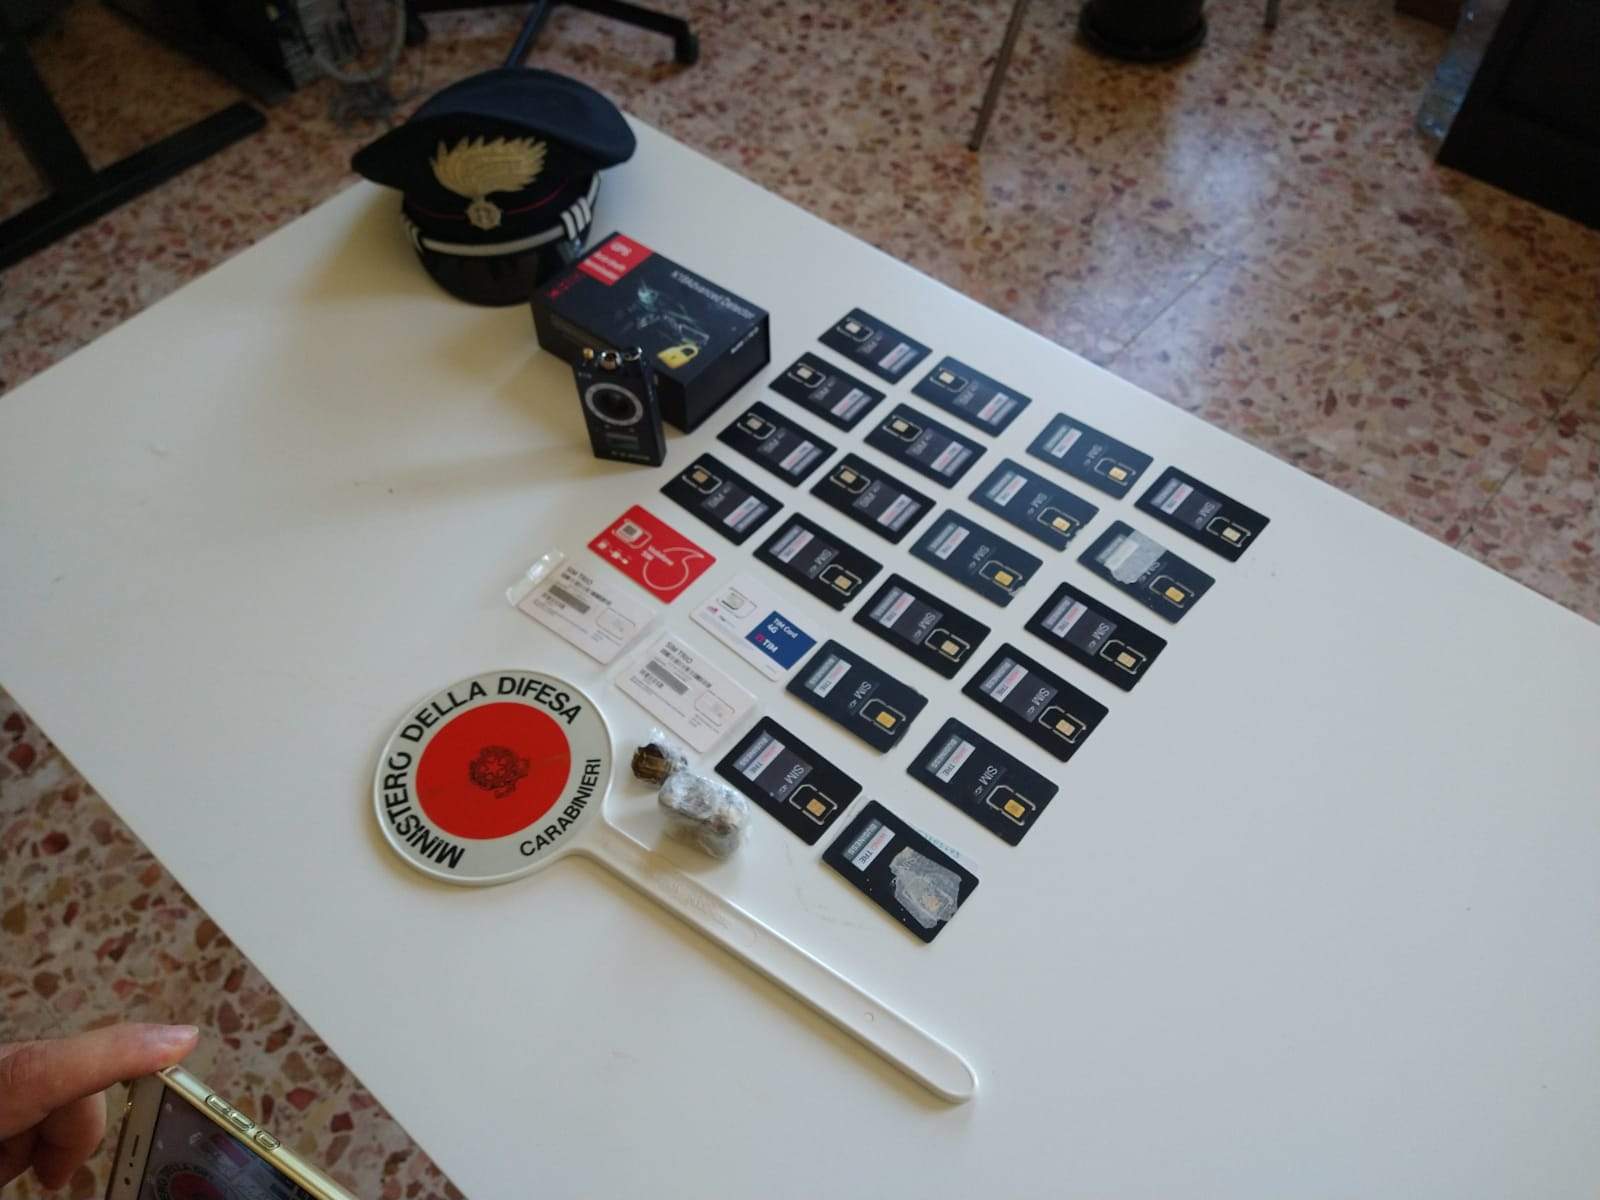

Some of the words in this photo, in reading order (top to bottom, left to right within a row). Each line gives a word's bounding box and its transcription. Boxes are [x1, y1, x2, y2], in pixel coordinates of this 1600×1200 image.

[765, 622, 779, 635] 4G
[772, 617, 785, 629] TIM
[782, 624, 799, 640] Card
[916, 611, 937, 630] SIM
[1090, 621, 1111, 640] SIM
[664, 640, 679, 654] SIM
[675, 649, 694, 665] TRIO
[761, 638, 779, 654] TIM
[852, 679, 873, 700] SIM
[1030, 686, 1051, 706] SIM
[400, 681, 487, 742] DELLA
[498, 677, 582, 724] DIFESA
[783, 762, 806, 784] SIM
[940, 761, 956, 777] TRE
[977, 763, 999, 786] SIM
[520, 758, 601, 857] CARABINIERI
[856, 848, 873, 866] TRE
